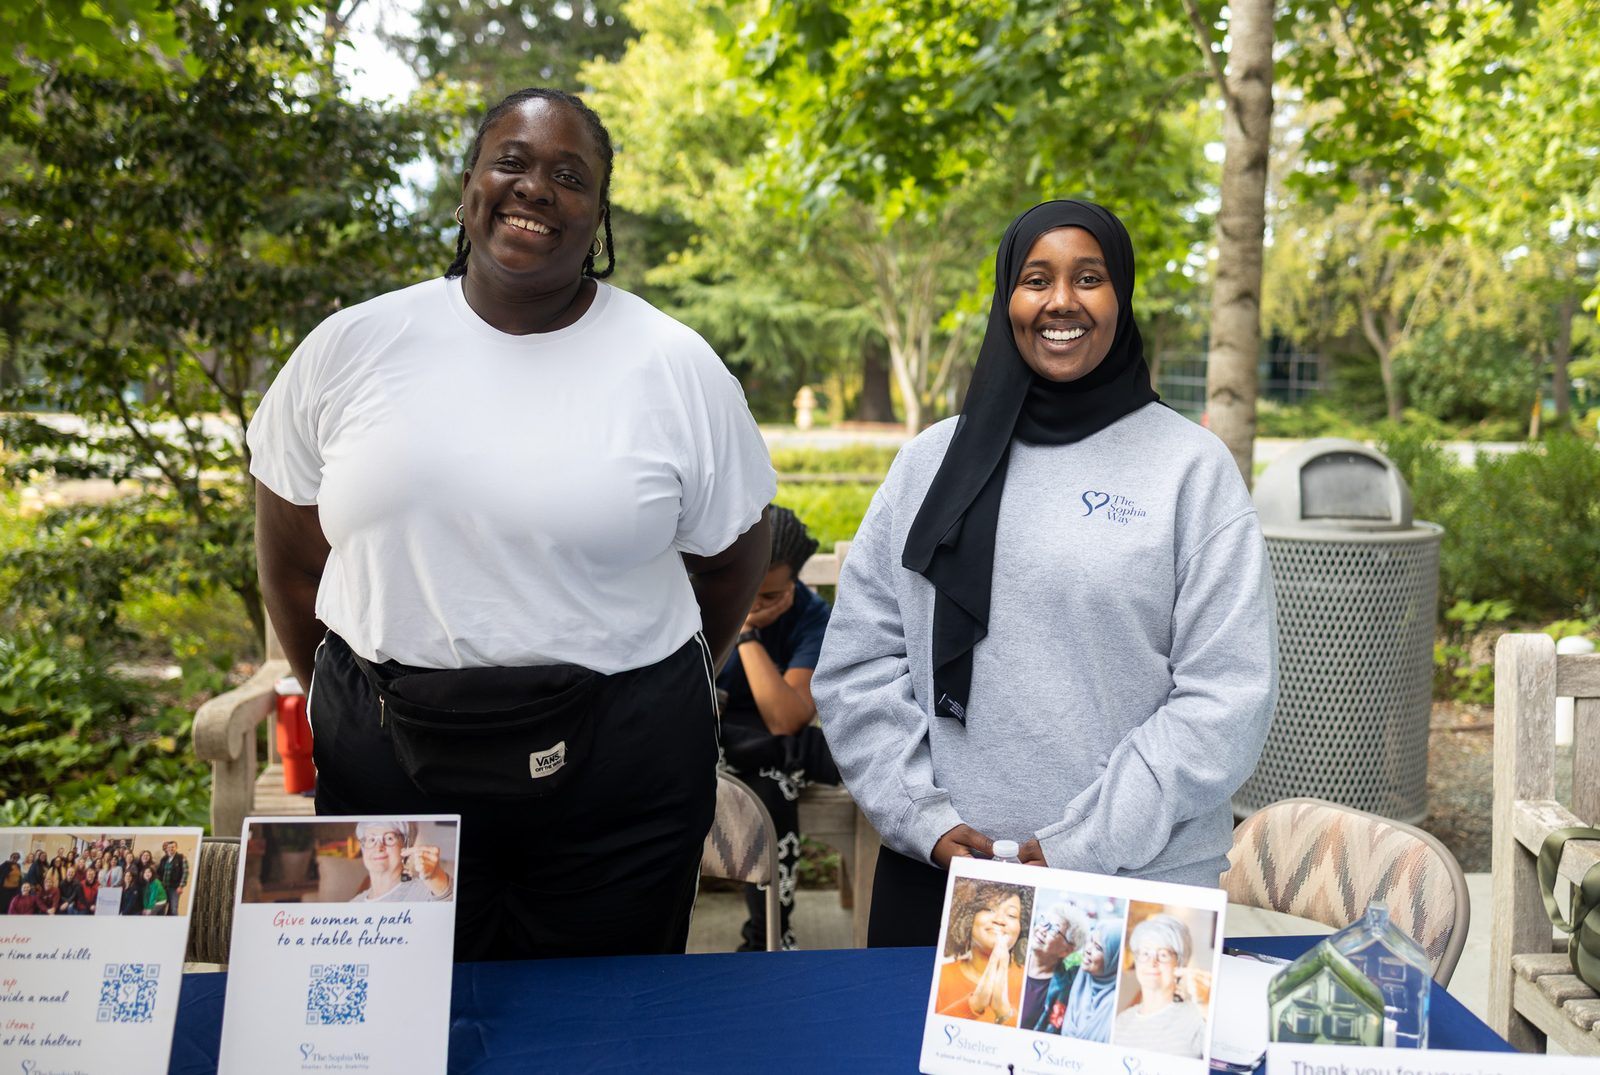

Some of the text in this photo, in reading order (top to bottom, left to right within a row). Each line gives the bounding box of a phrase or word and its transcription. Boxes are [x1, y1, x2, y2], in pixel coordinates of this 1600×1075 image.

[1112, 494, 1134, 507] The
[1109, 503, 1146, 517] Sophia
[1107, 511, 1131, 527] Way
[536, 750, 561, 767] VANS
[273, 909, 413, 932] Give women a path
[277, 929, 409, 948] to a stable future.
[8, 949, 32, 960] time
[35, 948, 59, 960] and
[61, 947, 92, 960] skills
[2, 979, 17, 992] up
[39, 990, 69, 1002] meal
[5, 1019, 35, 1030] items
[2, 1032, 82, 1047] at the shelters
[956, 1038, 998, 1054] Shelter
[1045, 1054, 1084, 1072] Safety
[1291, 1060, 1350, 1075] Thank
